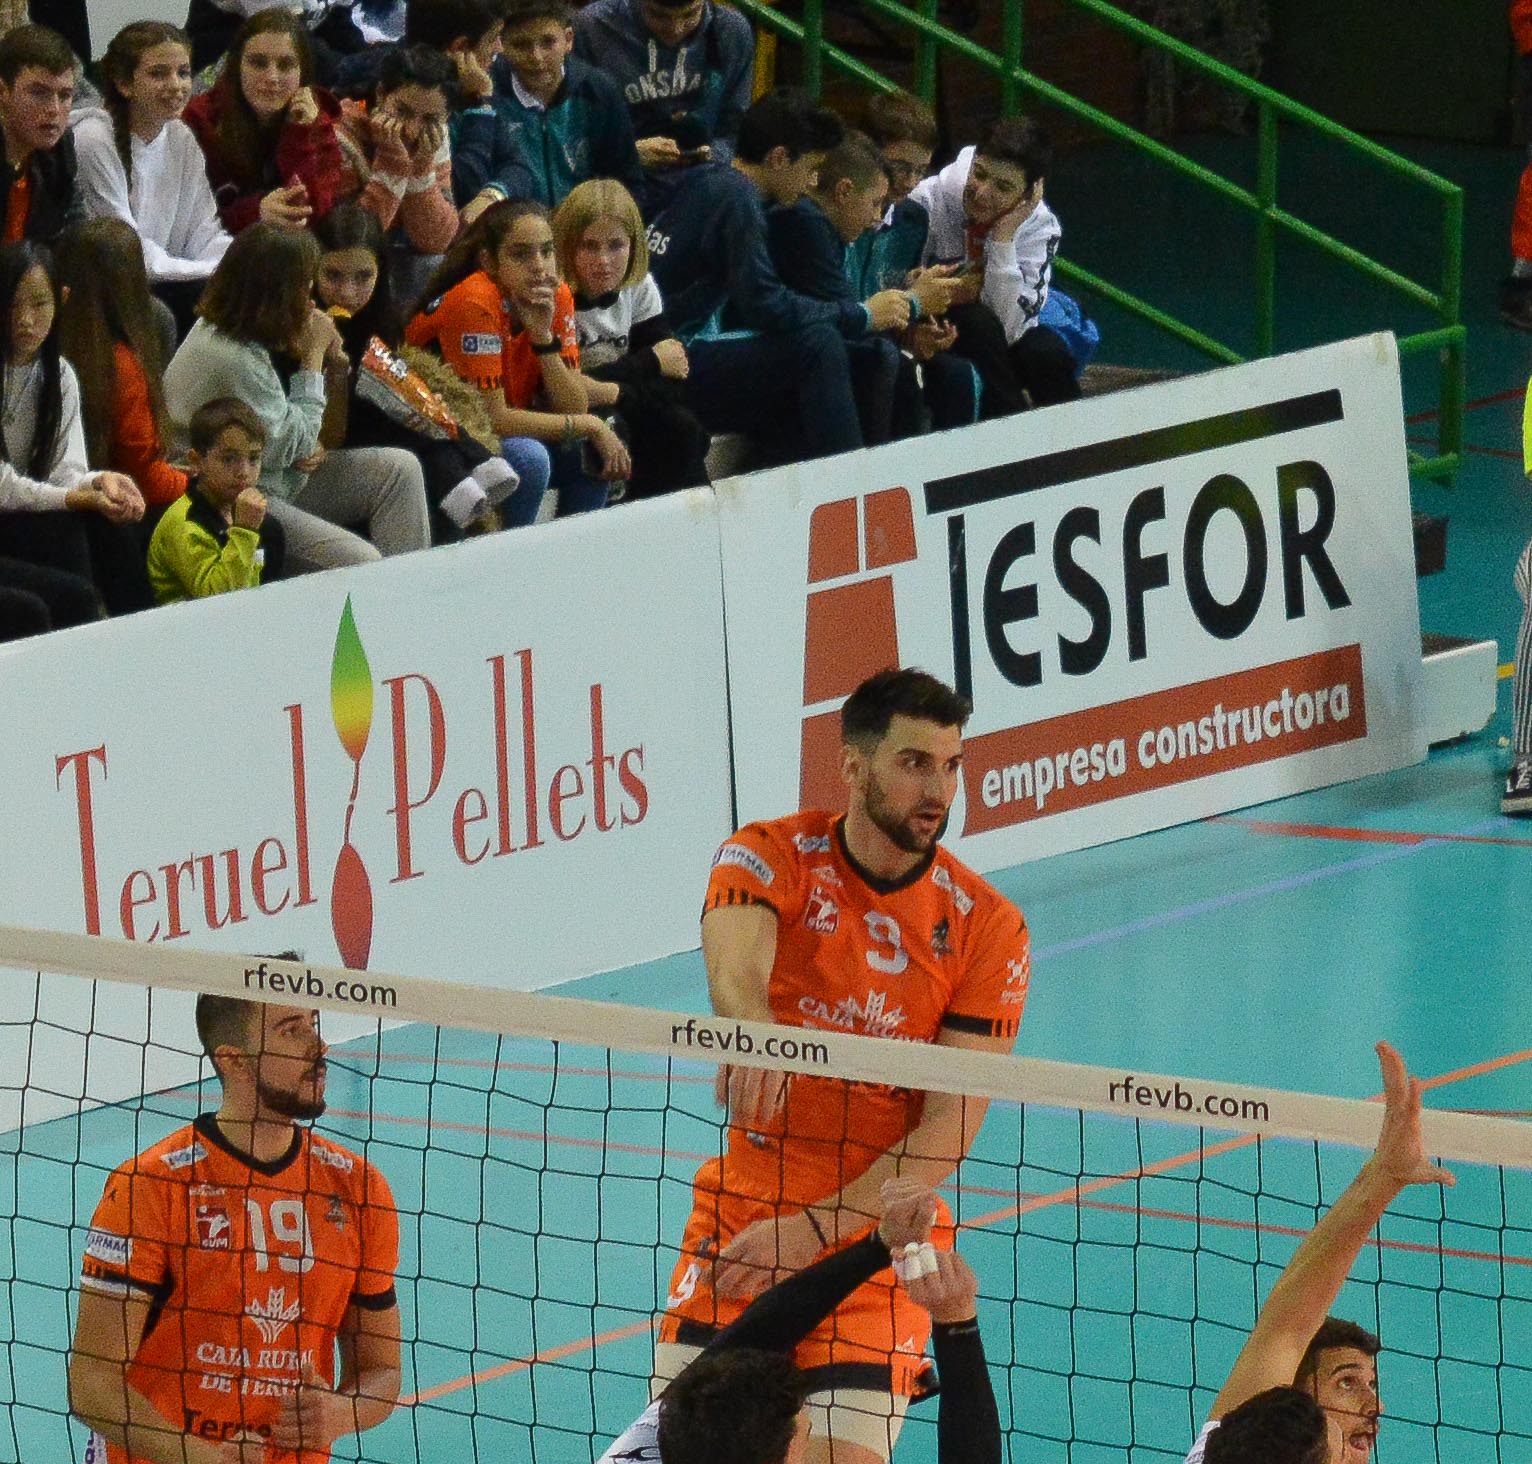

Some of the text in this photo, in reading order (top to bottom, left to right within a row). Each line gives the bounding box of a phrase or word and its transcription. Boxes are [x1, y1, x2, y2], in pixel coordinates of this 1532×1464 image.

[923, 388, 1352, 713] TESFOR
[981, 680, 1351, 810] empresa constructora
[55, 648, 650, 945] Teruel Pellets
[243, 964, 398, 1007] rfevb.com
[670, 1019, 830, 1065] rfevb.com
[1107, 1076, 1271, 1122] rfevb.com
[244, 1198, 315, 1273] 19
[200, 1372, 232, 1394] DE
